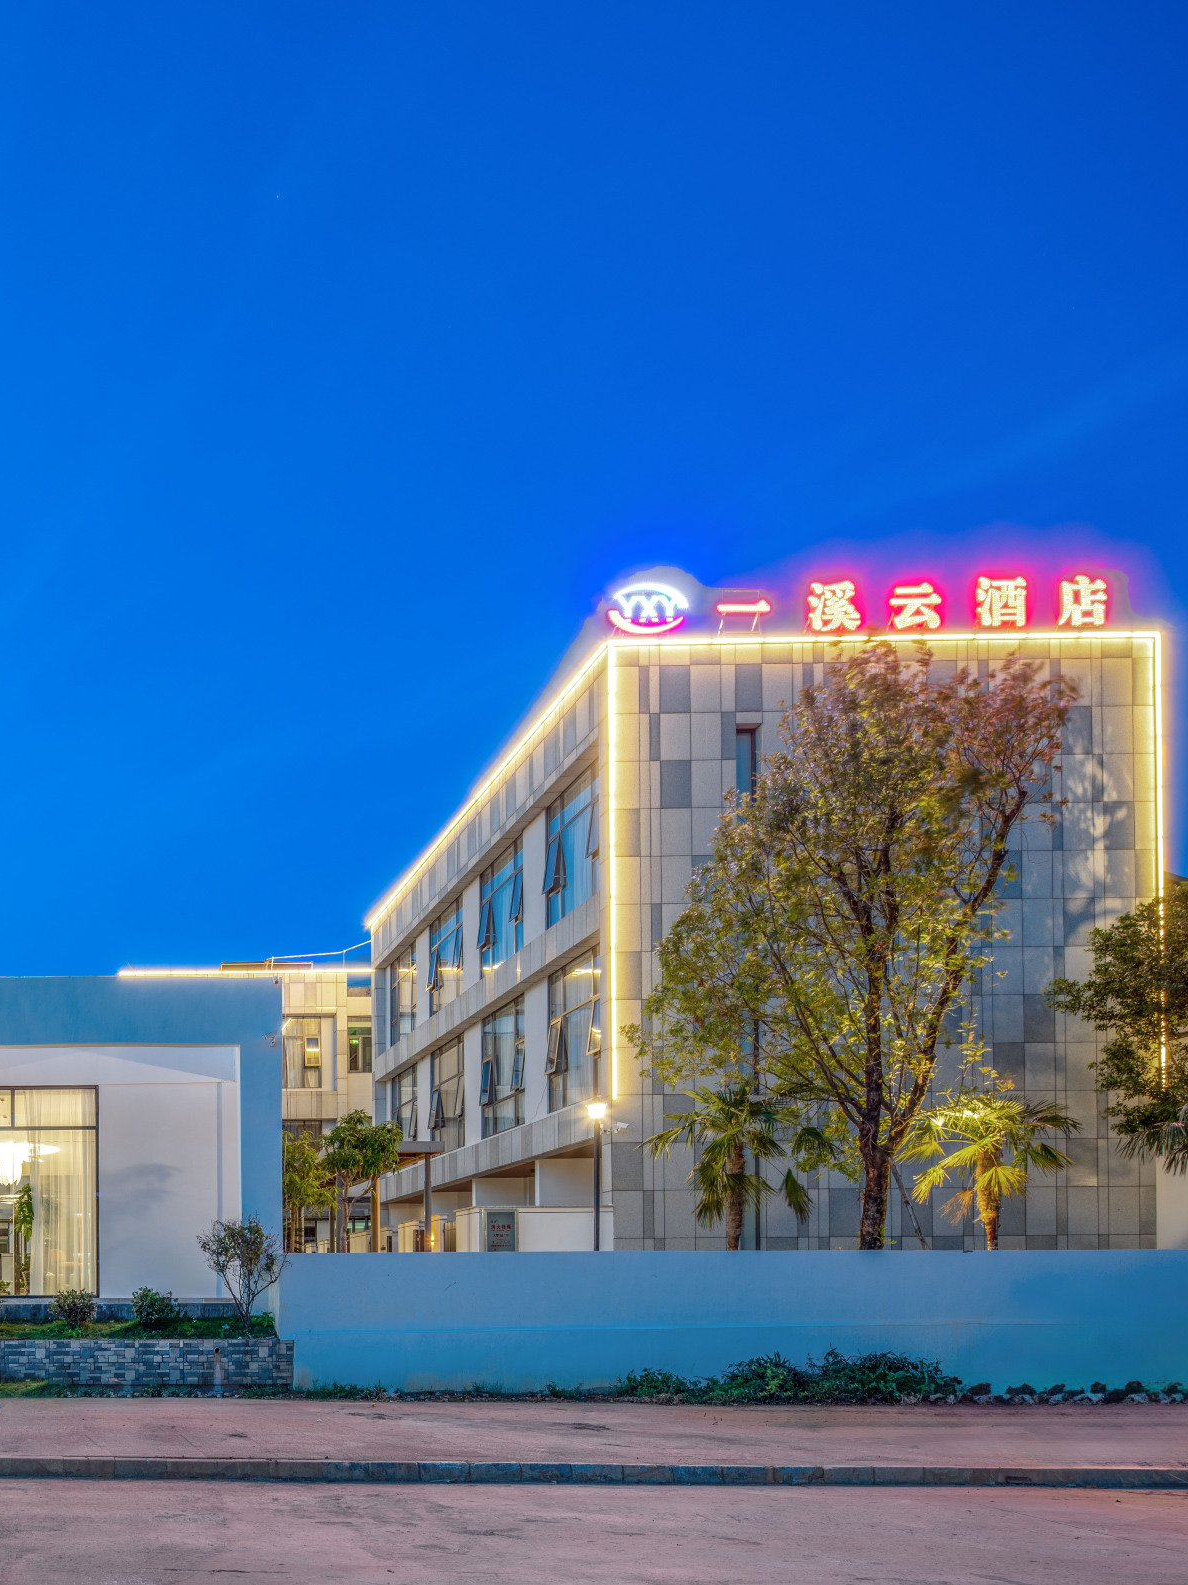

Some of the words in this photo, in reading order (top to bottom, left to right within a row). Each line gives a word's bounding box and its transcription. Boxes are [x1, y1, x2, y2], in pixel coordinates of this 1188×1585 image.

[617, 594, 680, 622] YXY
[717, 575, 1107, 631] 一溪云酒店
